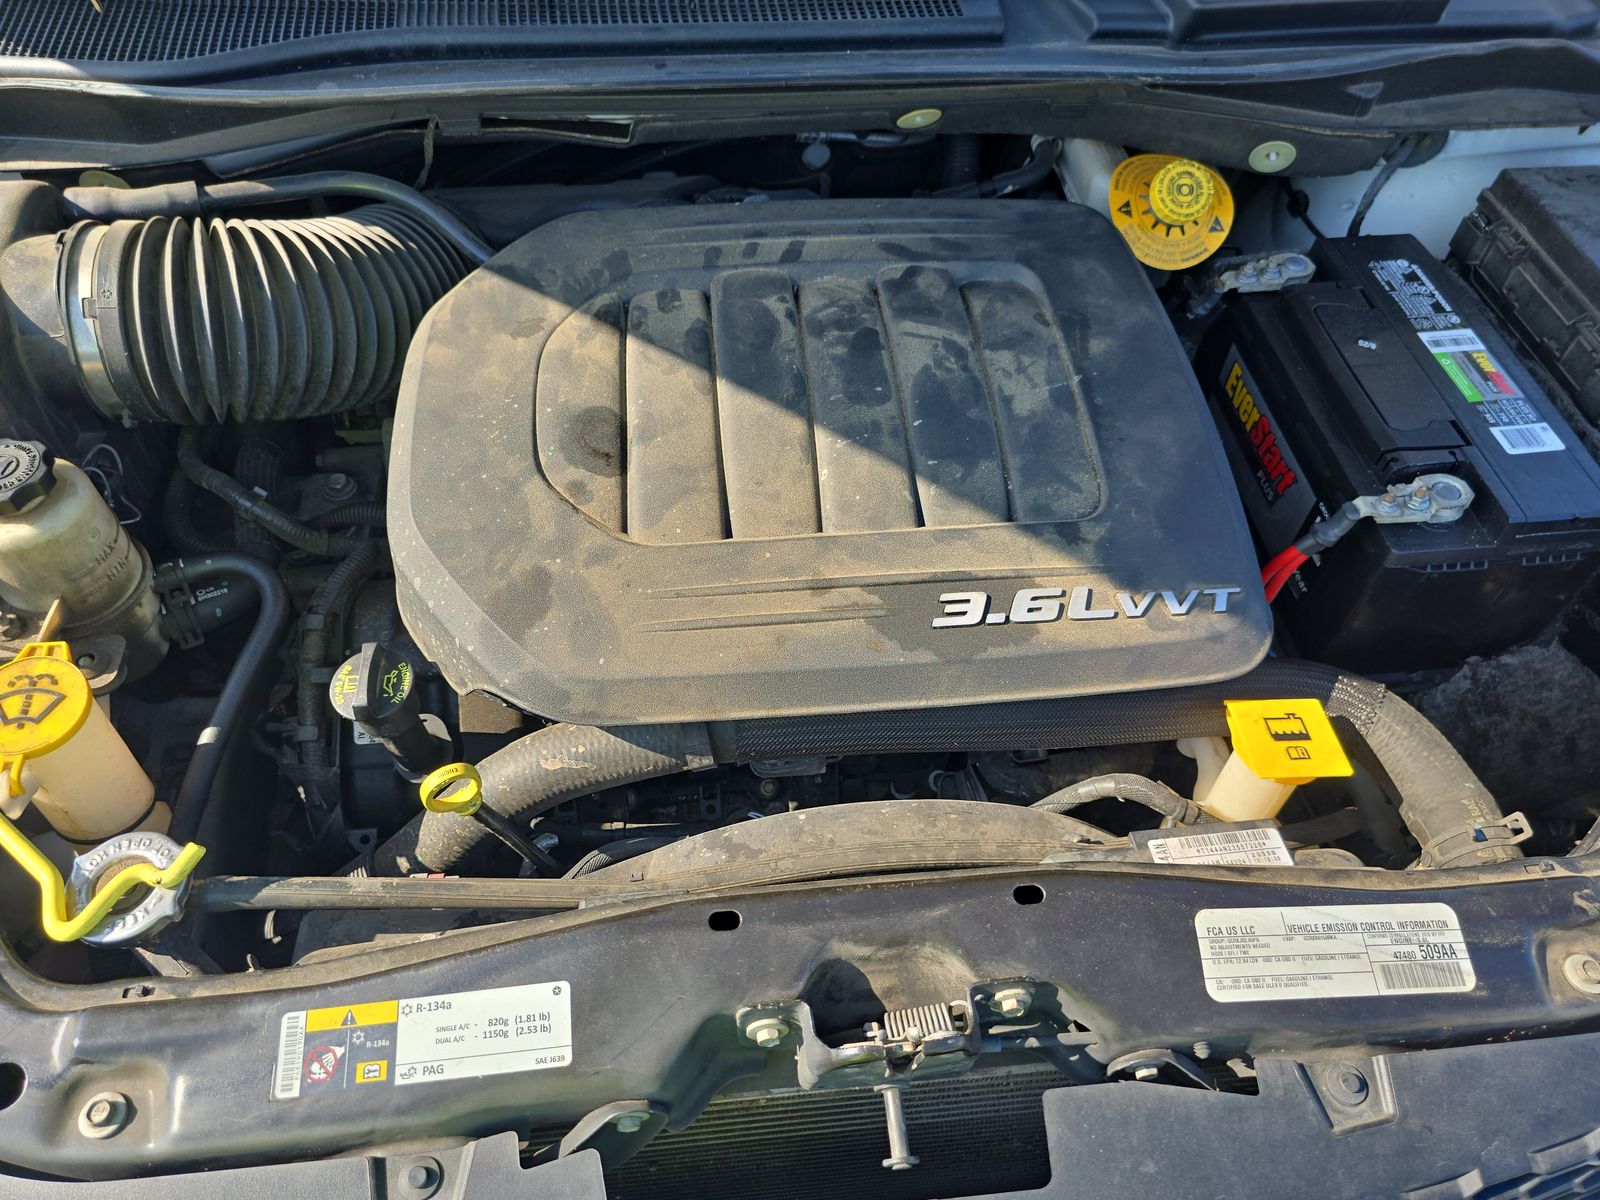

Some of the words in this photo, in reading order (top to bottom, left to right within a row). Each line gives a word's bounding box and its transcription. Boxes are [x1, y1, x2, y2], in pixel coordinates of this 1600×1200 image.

[1224, 361, 1297, 497] EverStart
[1256, 470, 1274, 500] PLUS
[932, 586, 1118, 628] 3.6L
[1116, 588, 1241, 616] VVT
[398, 662, 410, 692] ENGINE
[390, 691, 405, 704] OIL
[1206, 926, 1222, 936] FCA
[1226, 926, 1238, 935] US
[1240, 925, 1256, 935] LLC
[1287, 924, 1319, 934] VEHICLE
[1322, 922, 1358, 933] EMISSION
[1360, 921, 1396, 932] CONTROL
[1397, 920, 1449, 930] INFORMATION
[1418, 944, 1458, 960] 509AA
[416, 1000, 452, 1013] R-134a
[458, 1023, 470, 1032] A/C
[488, 1018, 509, 1028] 820g
[514, 1014, 536, 1026] (1.81
[539, 1012, 550, 1023] lb)
[436, 1037, 452, 1045] DUAL
[453, 1035, 465, 1043] A/C
[483, 1029, 509, 1040] 1150g
[516, 1026, 538, 1037] (2.53
[540, 1023, 552, 1034] lb)
[422, 1064, 444, 1076] PAG
